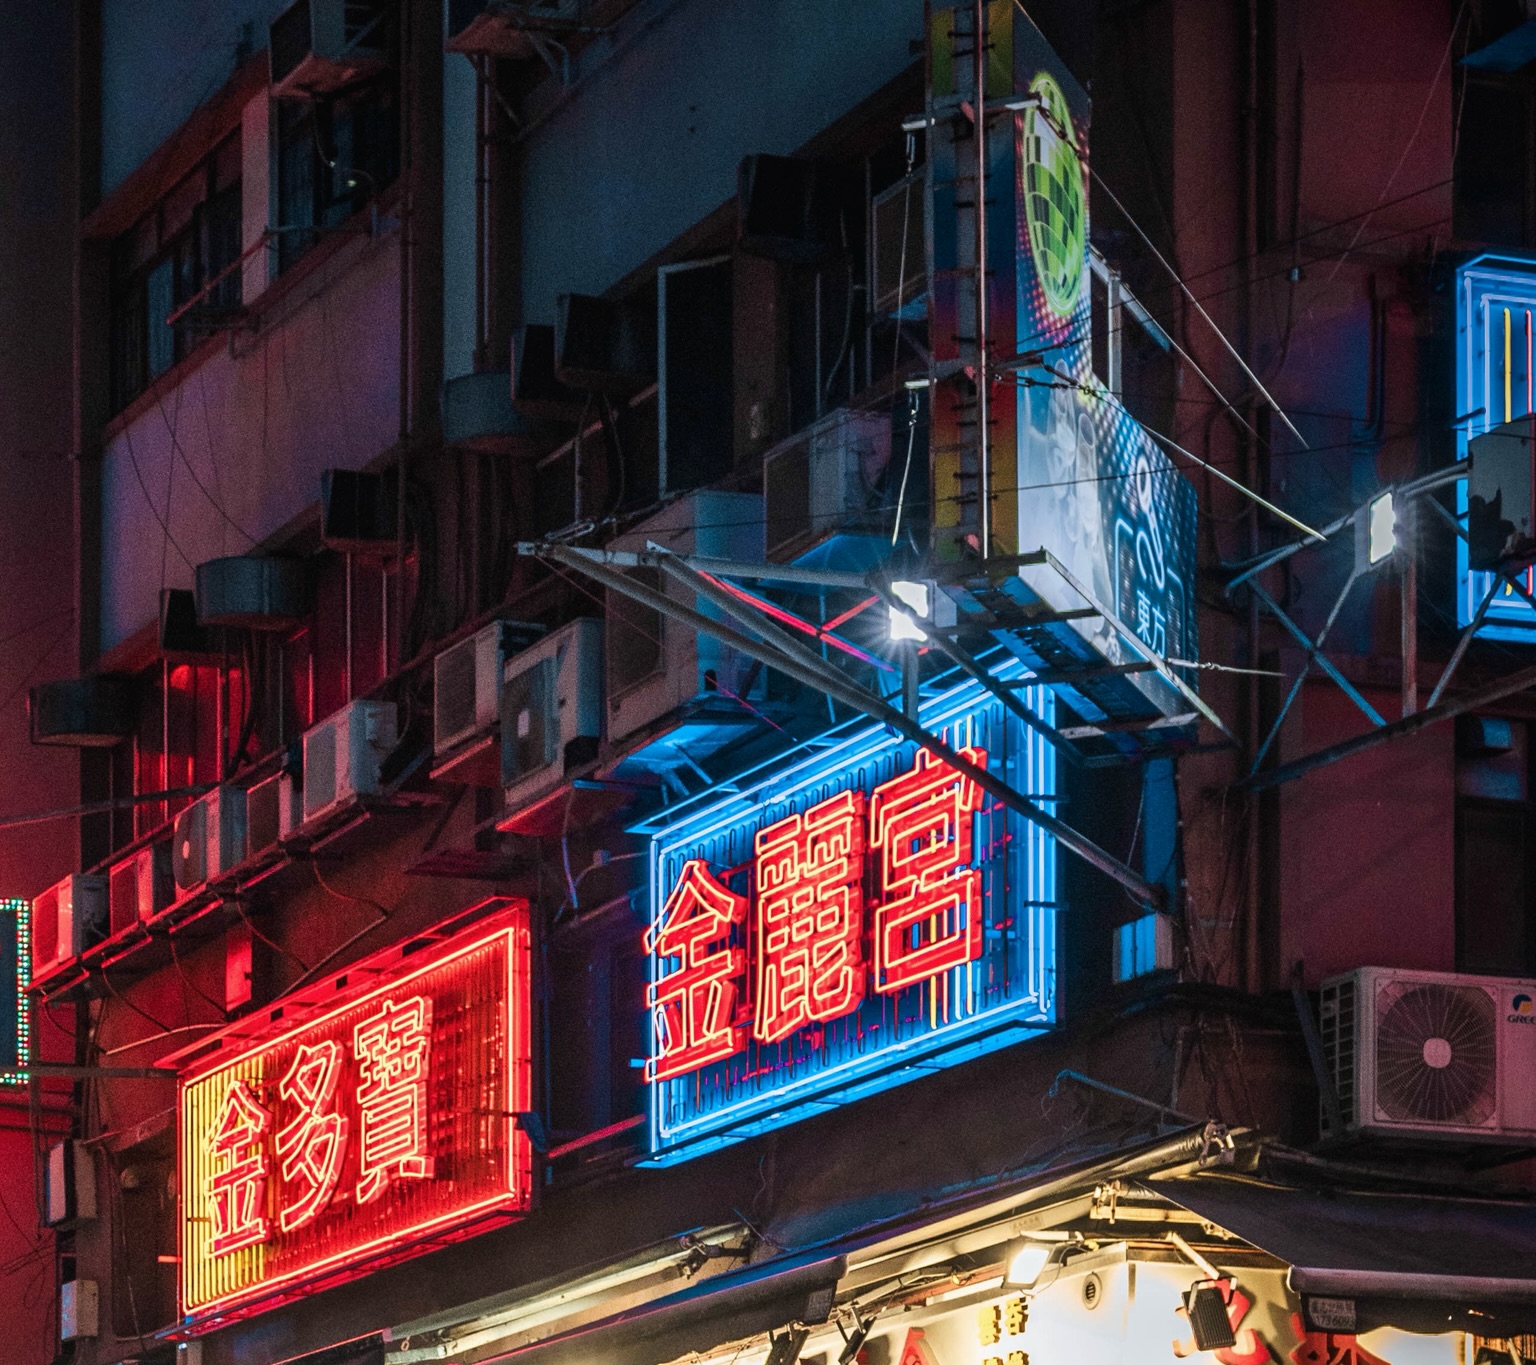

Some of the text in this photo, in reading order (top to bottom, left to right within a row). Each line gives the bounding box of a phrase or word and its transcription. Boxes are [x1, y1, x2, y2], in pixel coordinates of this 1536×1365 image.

[643, 745, 988, 1083] 金麗宮
[203, 996, 432, 1260] 金多寶
